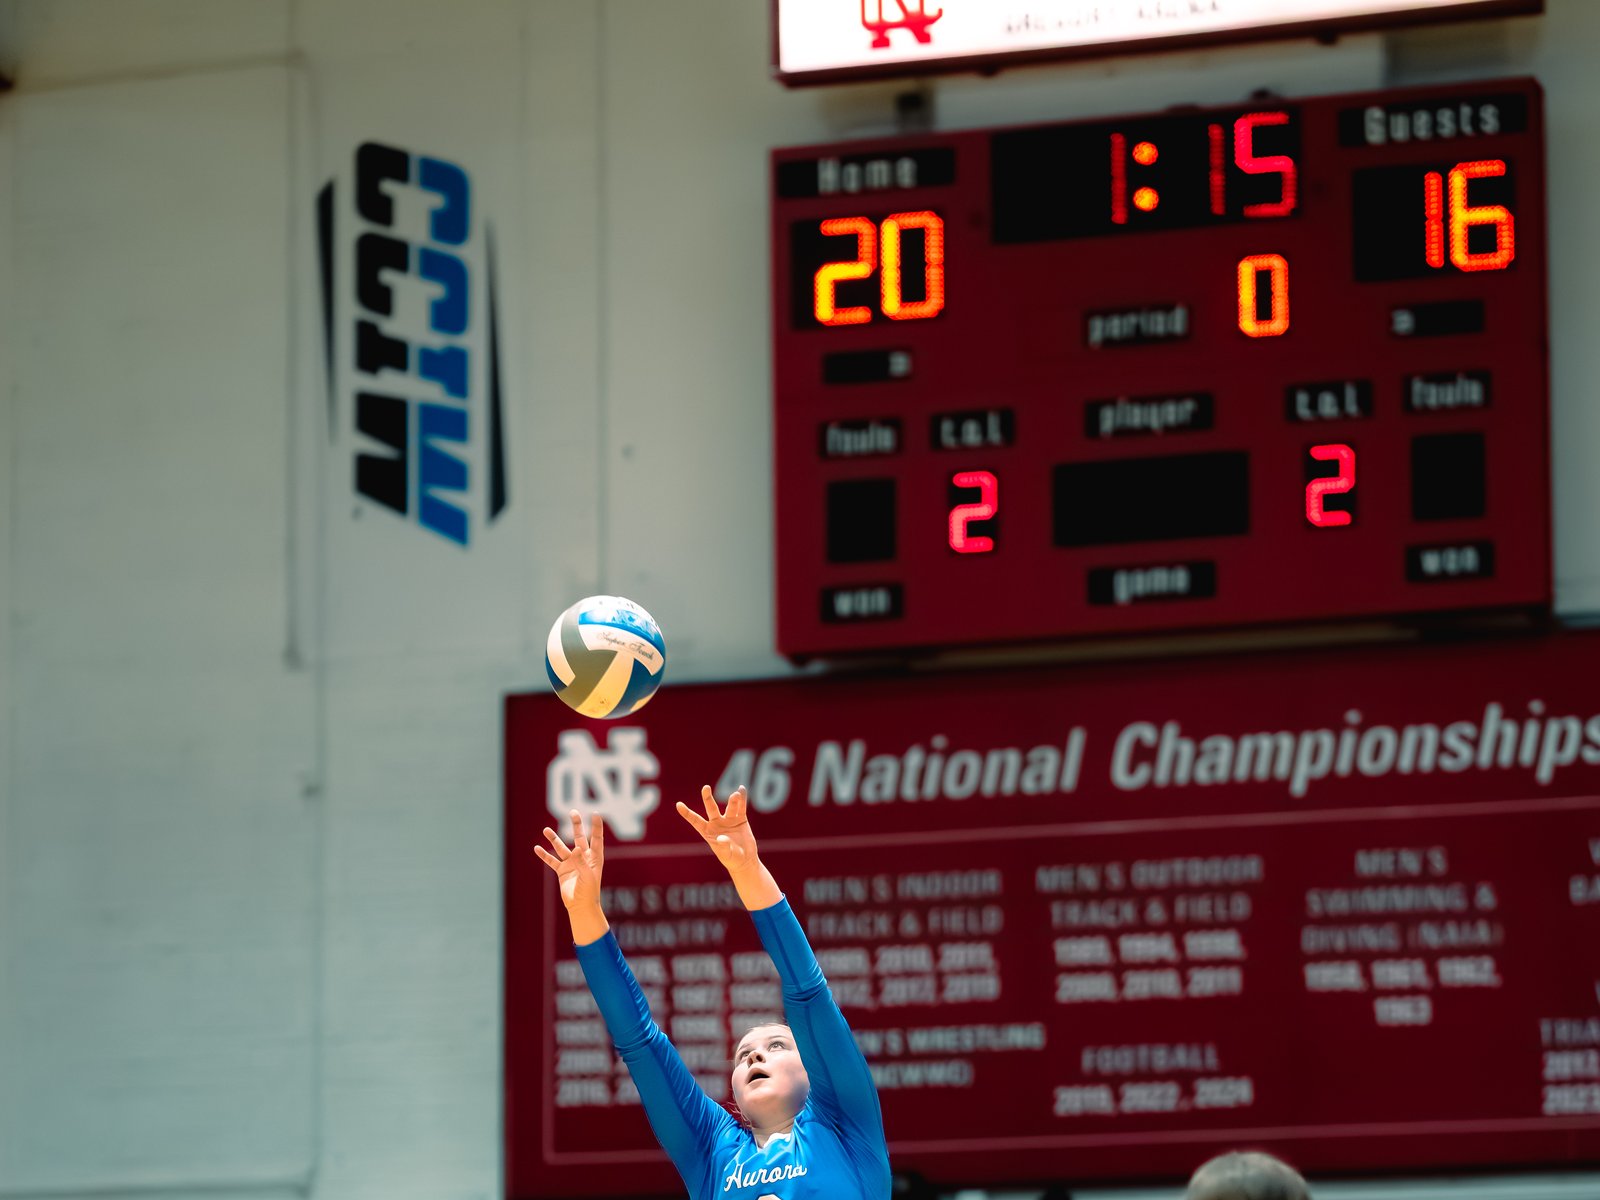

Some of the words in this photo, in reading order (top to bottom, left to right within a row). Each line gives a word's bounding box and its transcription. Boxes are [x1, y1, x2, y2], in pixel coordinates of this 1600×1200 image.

[1364, 103, 1499, 144] Guests
[818, 157, 917, 195] Home
[1111, 112, 1297, 225] 1:15
[1424, 160, 1515, 271] 16
[814, 211, 944, 326] 20
[1238, 254, 1289, 337] 0
[1089, 306, 1188, 346] period
[1102, 398, 1197, 436] player
[1306, 444, 1355, 527] 2
[949, 471, 998, 553] 2
[1421, 547, 1478, 574] won
[834, 588, 890, 617] won
[1114, 567, 1190, 604] game
[713, 744, 794, 812] 46
[809, 726, 1086, 806] National
[898, 868, 1001, 898] INDOOR
[1131, 855, 1263, 889] OUTDOOR
[1051, 898, 1137, 929] TRACK
[1173, 892, 1252, 923] FIELD
[1306, 882, 1468, 917] SWIMMING
[807, 912, 890, 938] TRACK
[928, 905, 1004, 935] FIELD
[1301, 922, 1400, 954] DIVING
[907, 1023, 1046, 1054] WRESTLING
[1081, 1041, 1219, 1076] FOOTBALL
[724, 1163, 808, 1192] Aurora
